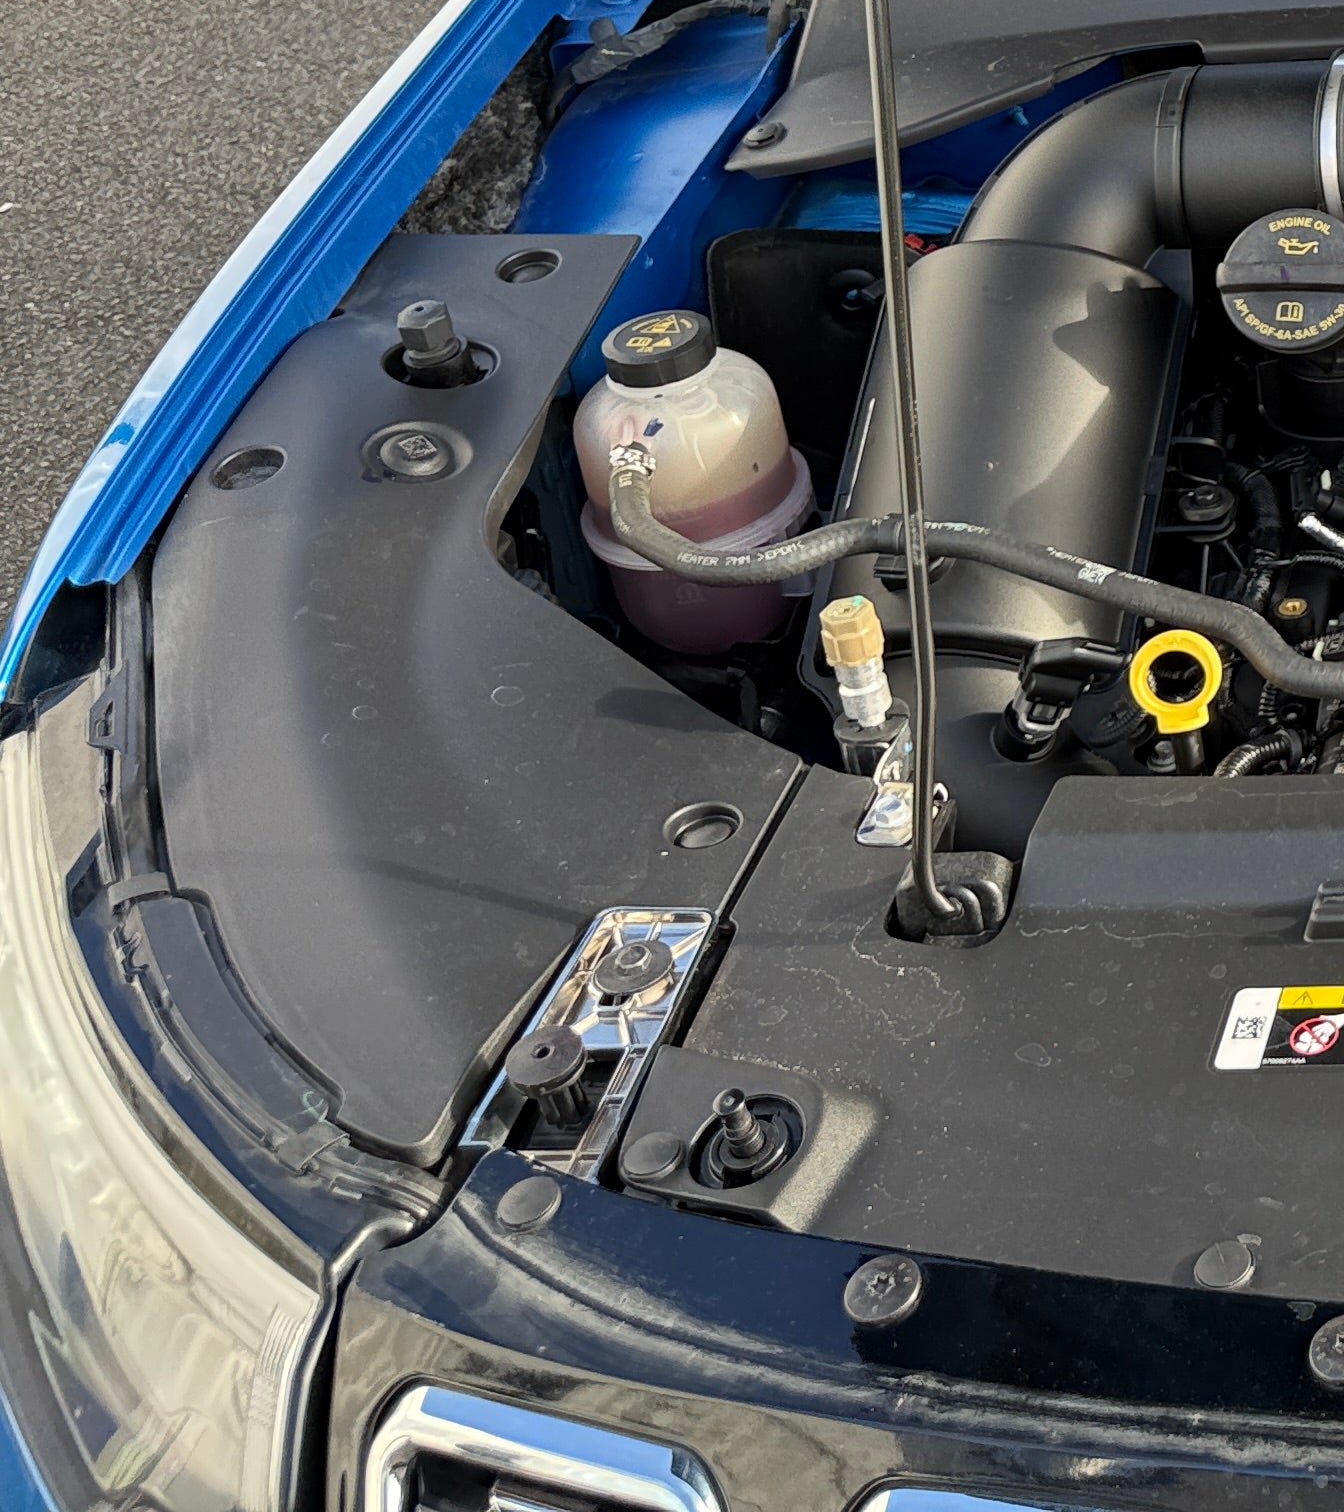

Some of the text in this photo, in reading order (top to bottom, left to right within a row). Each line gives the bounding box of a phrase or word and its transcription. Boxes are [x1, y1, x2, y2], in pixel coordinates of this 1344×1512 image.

[1268, 216, 1331, 235] ENGINE OIL
[1232, 298, 1250, 317] API
[677, 551, 719, 566] HEATER
